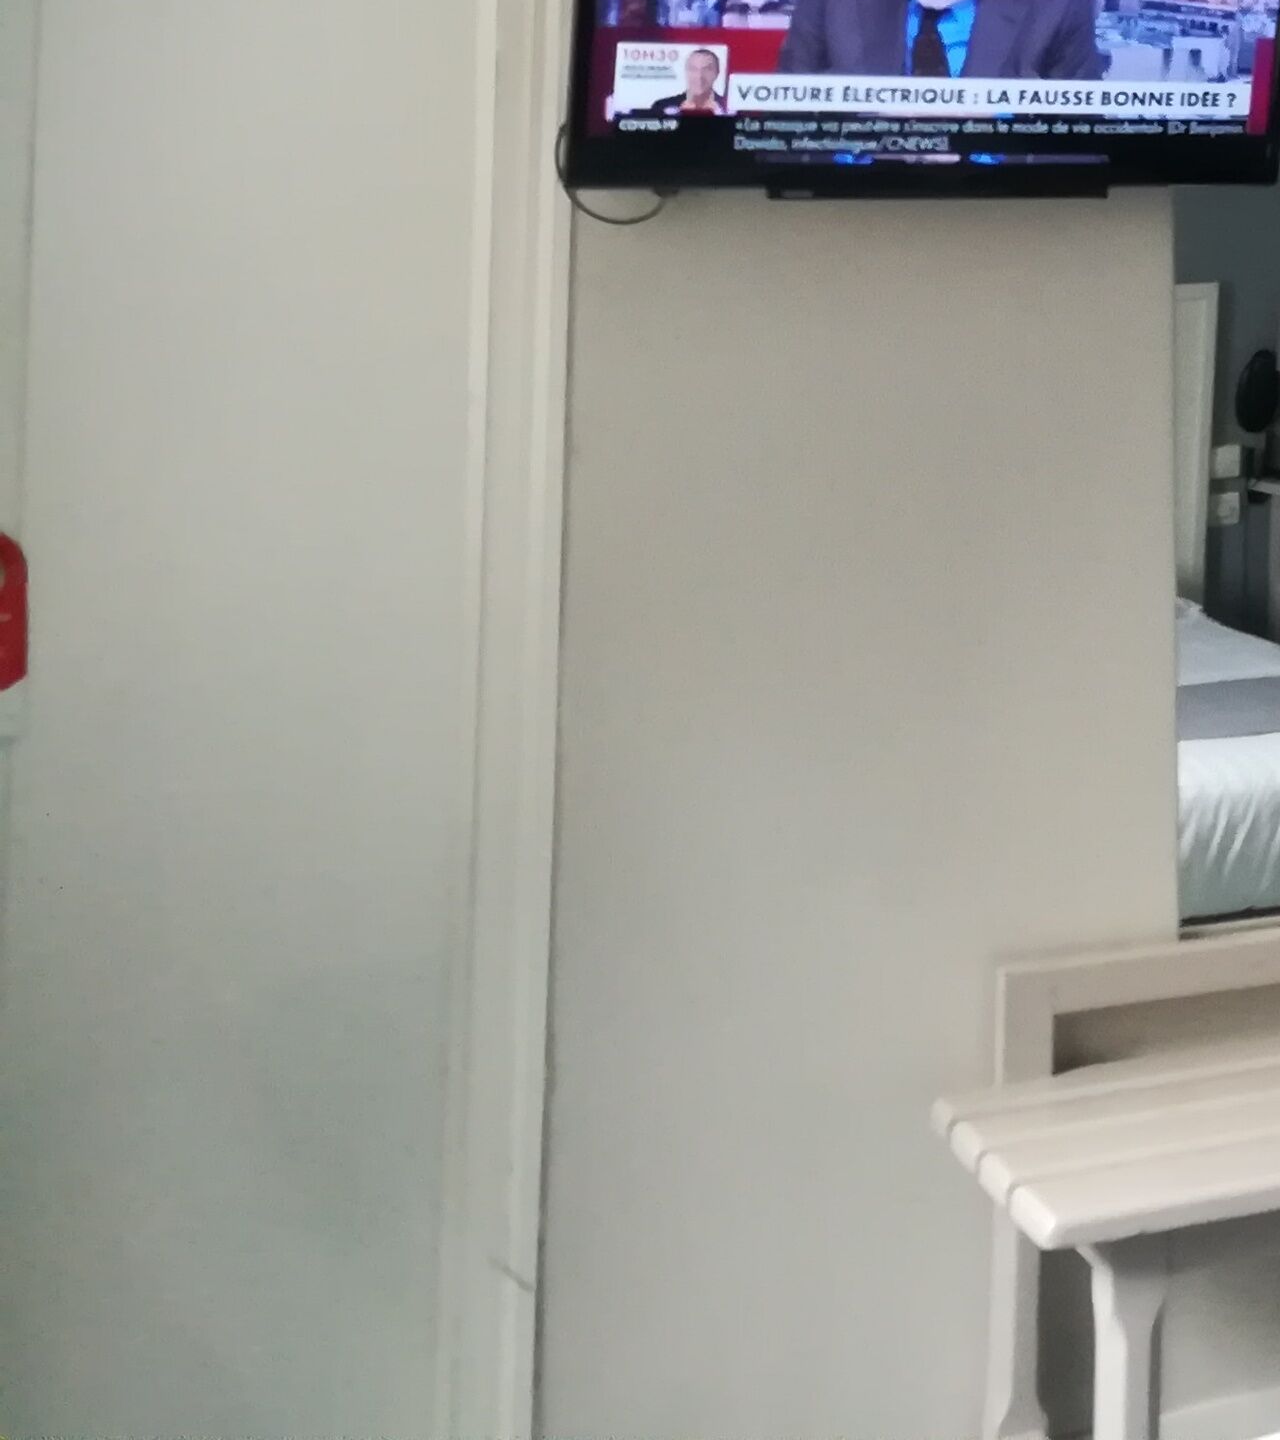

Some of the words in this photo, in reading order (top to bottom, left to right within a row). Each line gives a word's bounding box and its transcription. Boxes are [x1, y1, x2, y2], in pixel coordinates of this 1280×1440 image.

[737, 85, 834, 102] VOITURE
[842, 84, 965, 105] ÉLECTRIQUE
[986, 89, 1011, 105] LA
[1018, 90, 1094, 106] FAUSSE
[1101, 90, 1174, 107] BONNE
[1180, 90, 1221, 107] IDÉE
